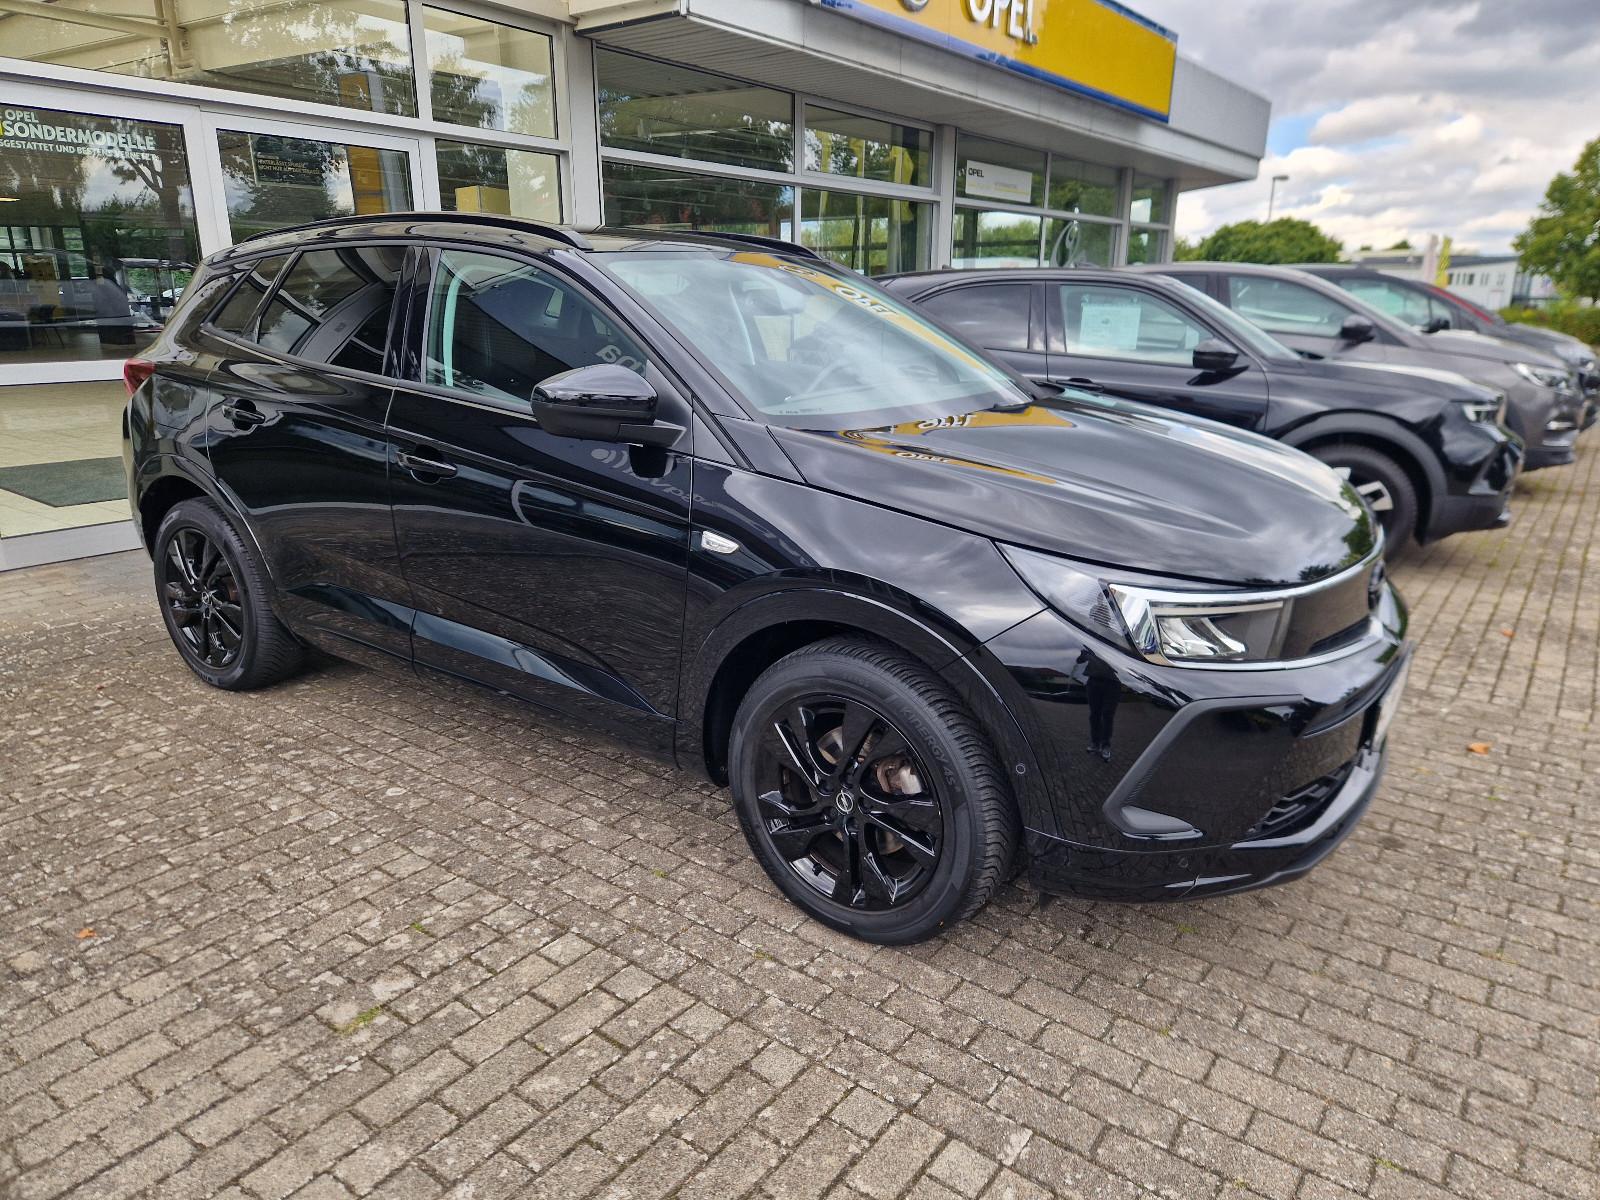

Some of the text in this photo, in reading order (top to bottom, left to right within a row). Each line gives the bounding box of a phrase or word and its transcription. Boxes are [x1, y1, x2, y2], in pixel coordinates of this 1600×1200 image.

[5, 109, 39, 123] OPEL
[2, 120, 156, 151] SONDERMODELLE
[56, 144, 75, 154] UND
[968, 167, 985, 178] OPEL
